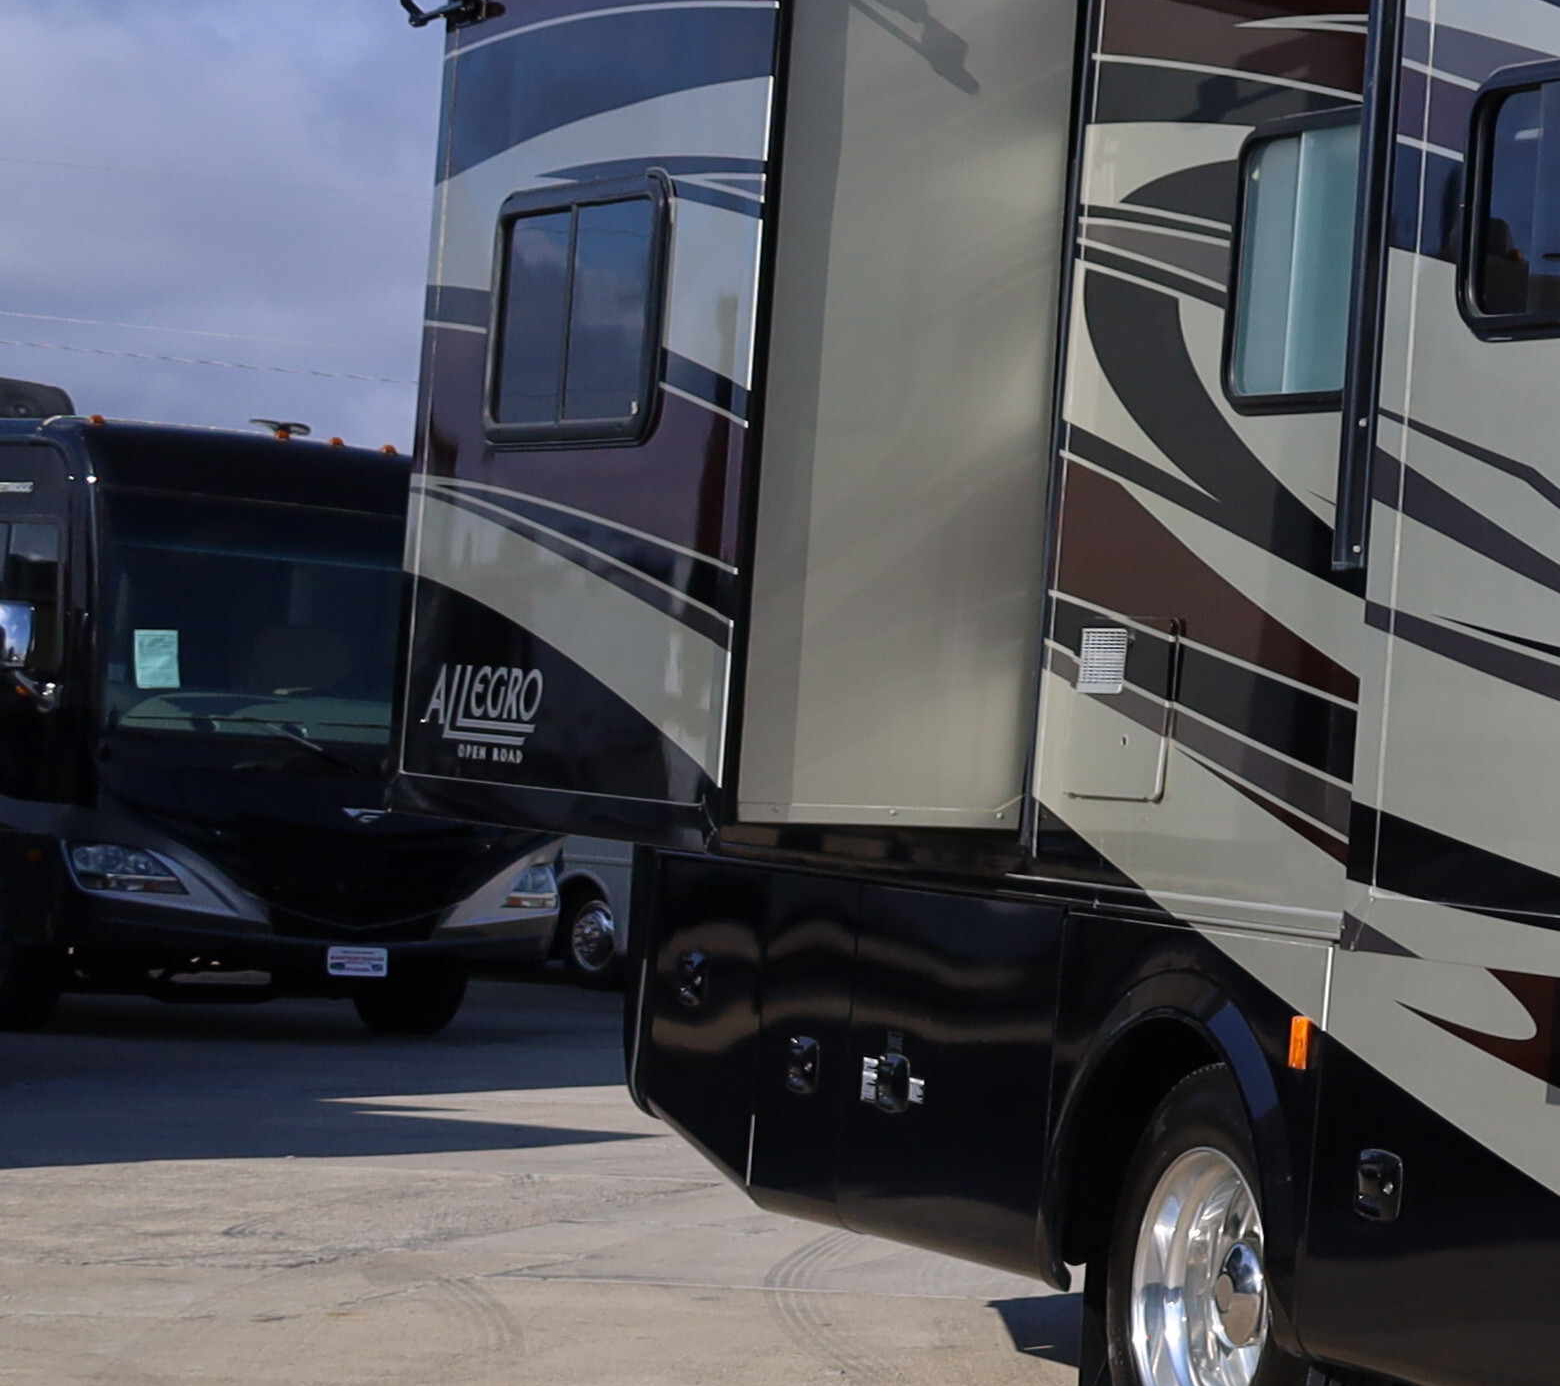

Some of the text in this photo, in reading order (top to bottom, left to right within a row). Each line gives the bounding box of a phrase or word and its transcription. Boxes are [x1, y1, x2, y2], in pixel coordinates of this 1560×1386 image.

[419, 663, 544, 746] ALLEGRO
[457, 744, 524, 765] OPEN ROAD
